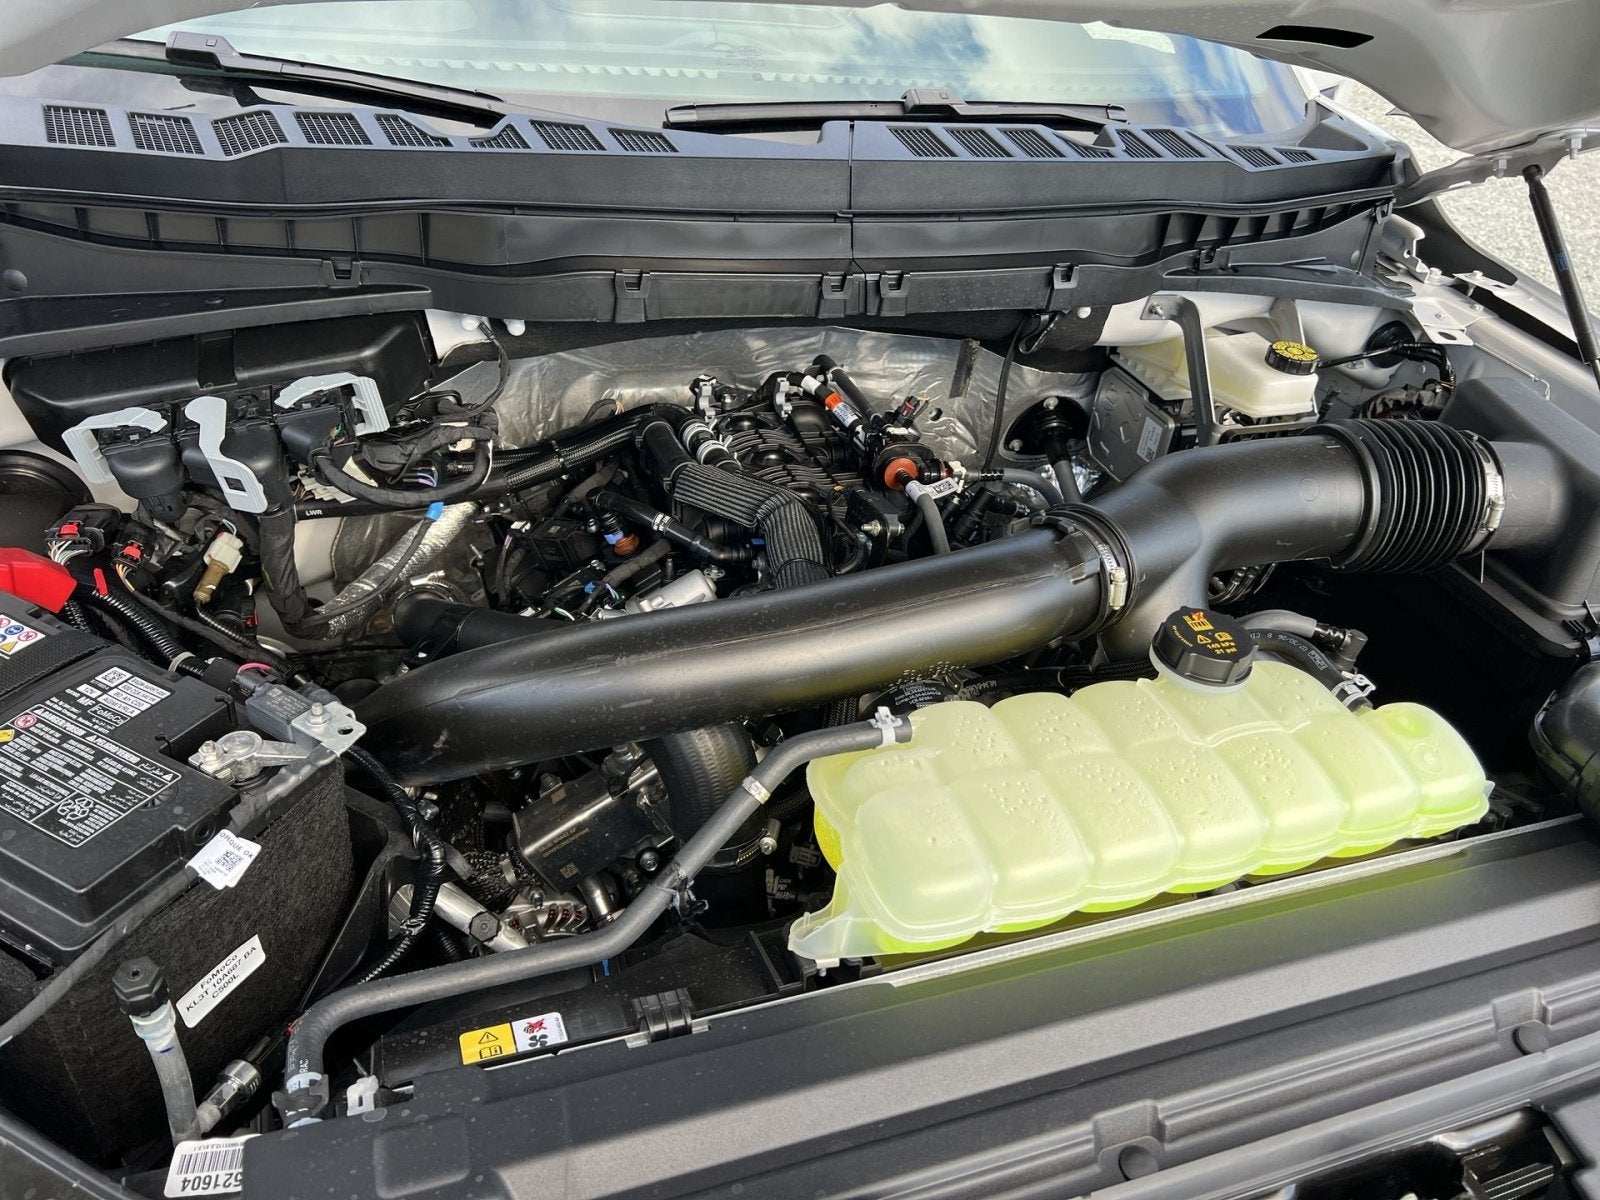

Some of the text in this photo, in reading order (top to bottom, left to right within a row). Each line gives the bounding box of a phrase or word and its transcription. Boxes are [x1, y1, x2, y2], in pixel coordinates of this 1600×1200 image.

[92, 703, 124, 725] FoMoCo
[186, 988, 210, 1012] KL3T
[243, 946, 256, 960] BA
[200, 954, 238, 989] FoMoCo
[212, 974, 240, 999] C500L
